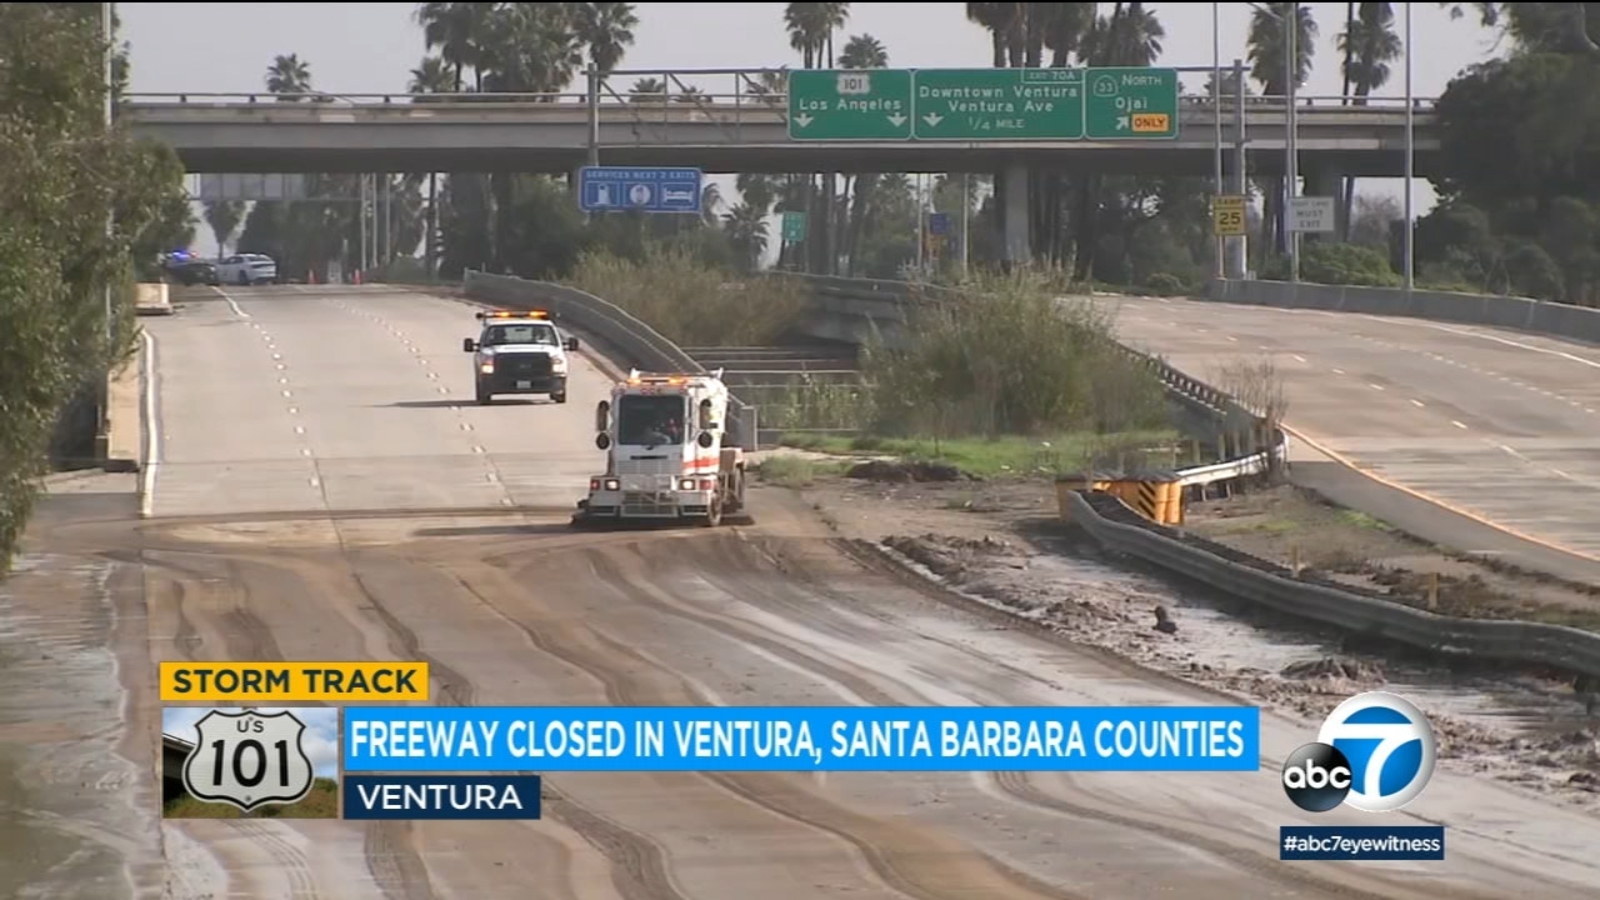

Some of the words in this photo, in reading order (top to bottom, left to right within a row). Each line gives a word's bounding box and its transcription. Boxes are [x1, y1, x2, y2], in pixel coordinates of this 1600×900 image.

[1052, 71, 1075, 80] 70A
[1122, 74, 1162, 85] NORTH
[844, 78, 863, 91] 101
[1098, 82, 1113, 92] 33
[919, 85, 1004, 98] Downtown
[1016, 84, 1078, 98] Ventura
[799, 98, 828, 111] Los
[837, 97, 902, 113] Angeles
[948, 99, 1014, 112] Ventura
[1024, 99, 1053, 112] Ave
[1115, 96, 1147, 112] Ojai
[969, 117, 990, 130] 1/4
[996, 117, 1025, 129] MILE
[1134, 117, 1166, 128] ONLY
[586, 170, 630, 179] SERVICES
[634, 171, 656, 179] NEXT
[659, 171, 667, 179] 2
[670, 171, 695, 179] EXITS
[1219, 212, 1241, 225] 25
[1296, 209, 1323, 218] MUST
[1299, 219, 1321, 228] EXIT
